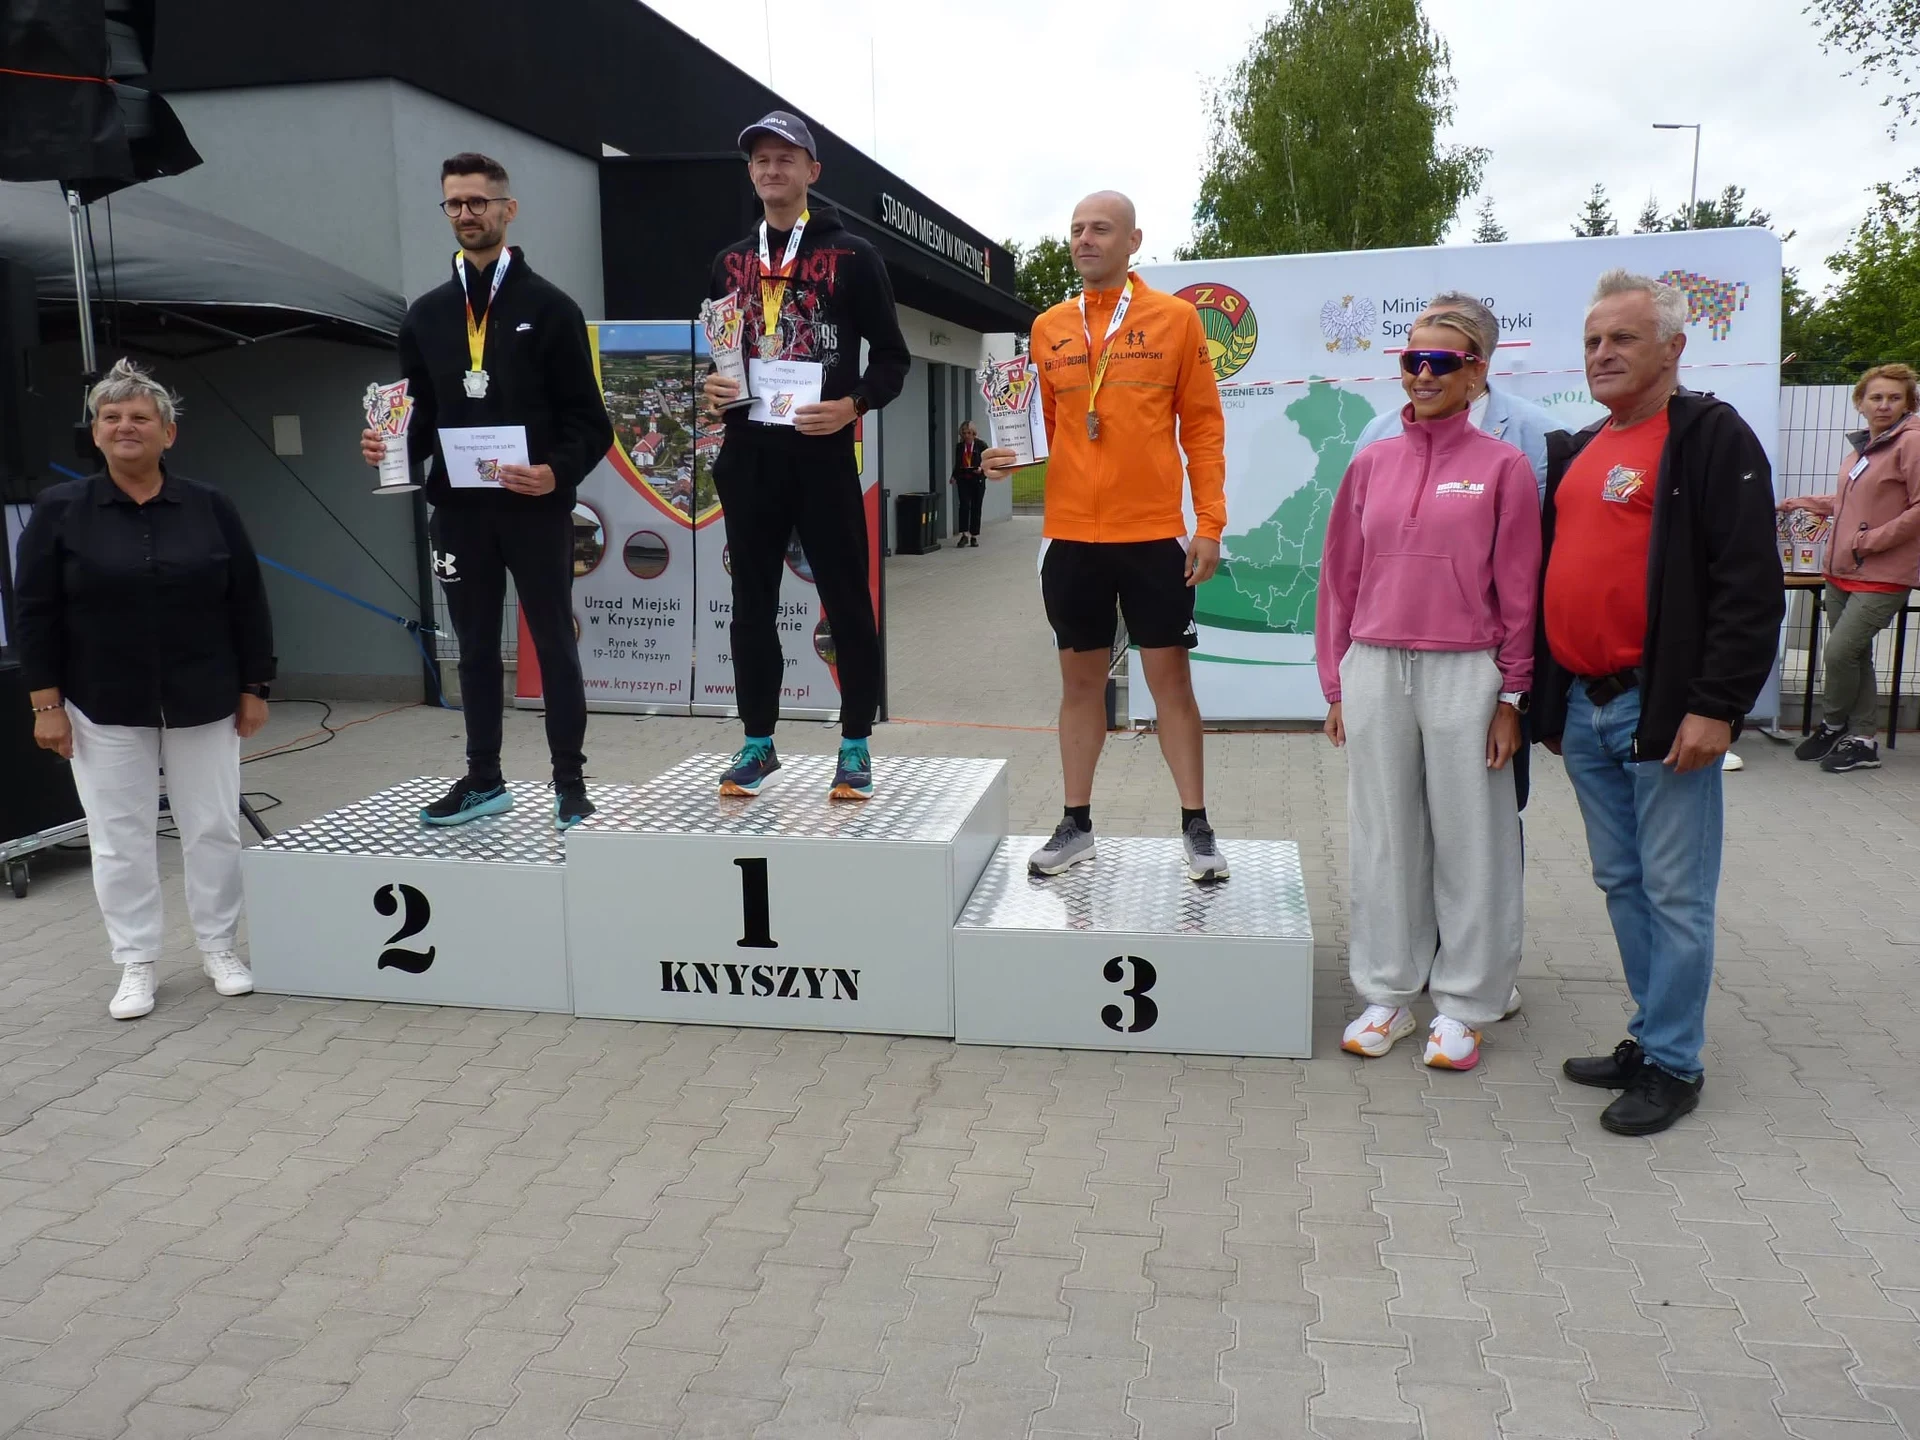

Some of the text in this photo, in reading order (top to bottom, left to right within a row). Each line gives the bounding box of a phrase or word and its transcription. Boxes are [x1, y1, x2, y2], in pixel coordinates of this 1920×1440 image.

[882, 192, 984, 275] STADION MIEJSKI W KNYSZYNIE
[1194, 288, 1240, 312] ZS
[1109, 351, 1163, 360] KALINOWSKI
[1257, 387, 1274, 396] LZS
[585, 596, 680, 613] Urząd Miejski
[709, 600, 733, 613] Urz
[589, 613, 676, 629] w Knyszynie
[714, 620, 725, 629] w
[608, 638, 657, 649] Rynek 39
[593, 649, 671, 663] 19-120 Knyszyn
[583, 677, 682, 694] www.knyszyn.pl
[734, 858, 778, 948] 1
[374, 884, 435, 973] 2
[660, 961, 860, 1000] KNYSZYN
[1101, 956, 1158, 1032] 3
